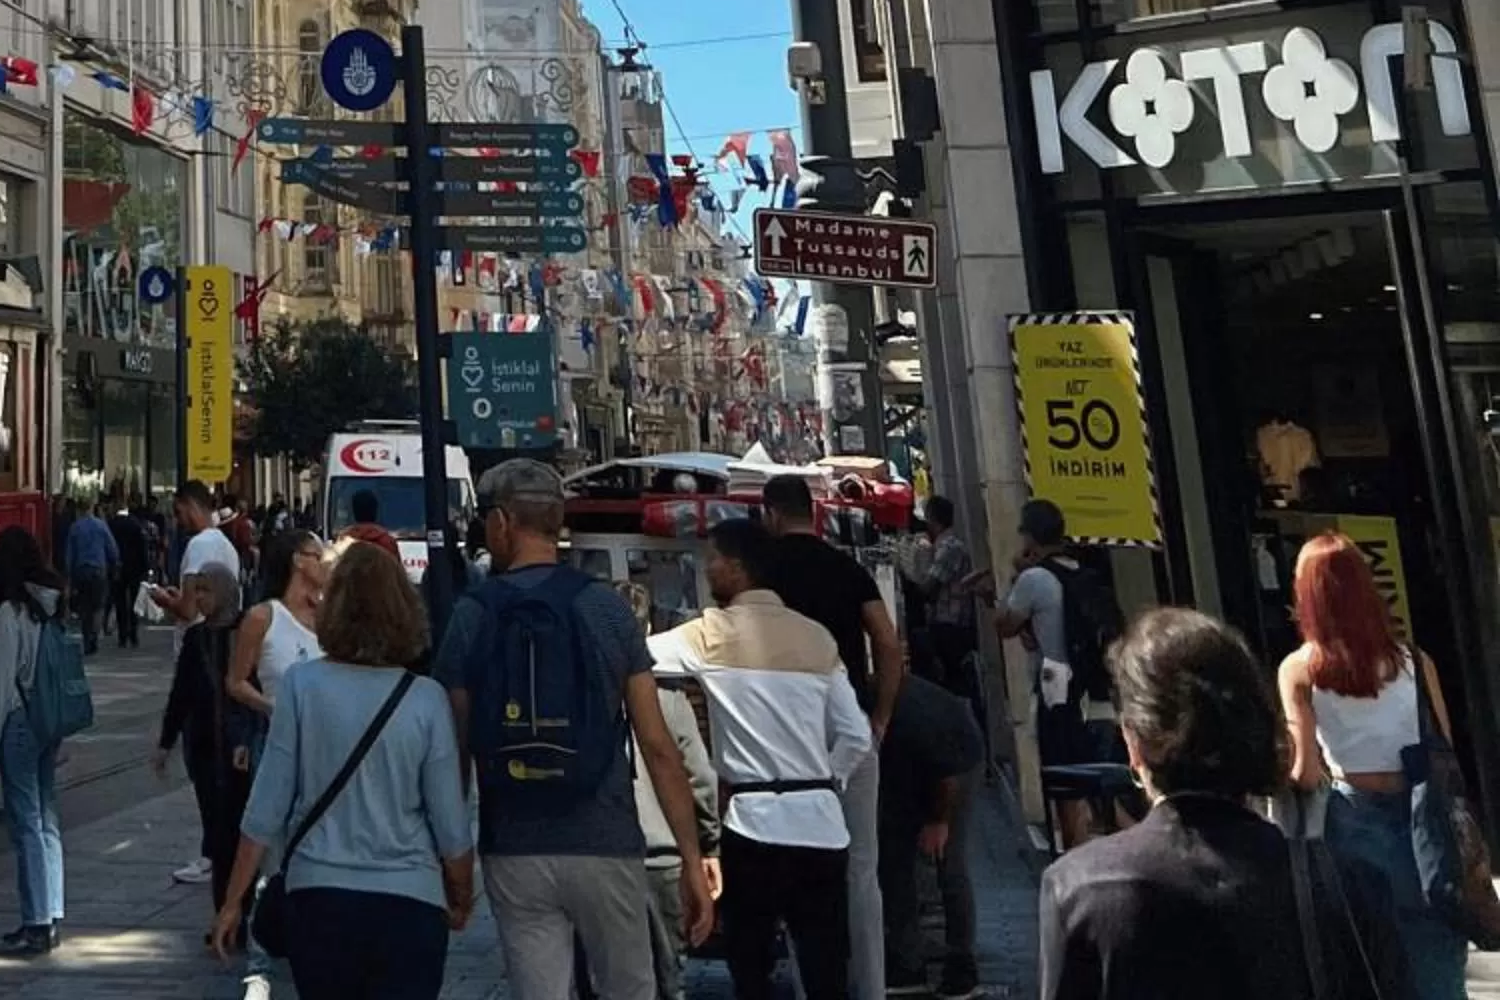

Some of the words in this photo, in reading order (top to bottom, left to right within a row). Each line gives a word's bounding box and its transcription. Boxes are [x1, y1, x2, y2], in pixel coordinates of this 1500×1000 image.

[1029, 20, 1472, 175] KOTON
[795, 218, 890, 239] Madame
[793, 237, 900, 260] Tussauds
[491, 377, 535, 393] Senin
[1046, 399, 1121, 451] 50
[357, 449, 391, 461] 112
[1050, 457, 1126, 478] İNDİRİM
